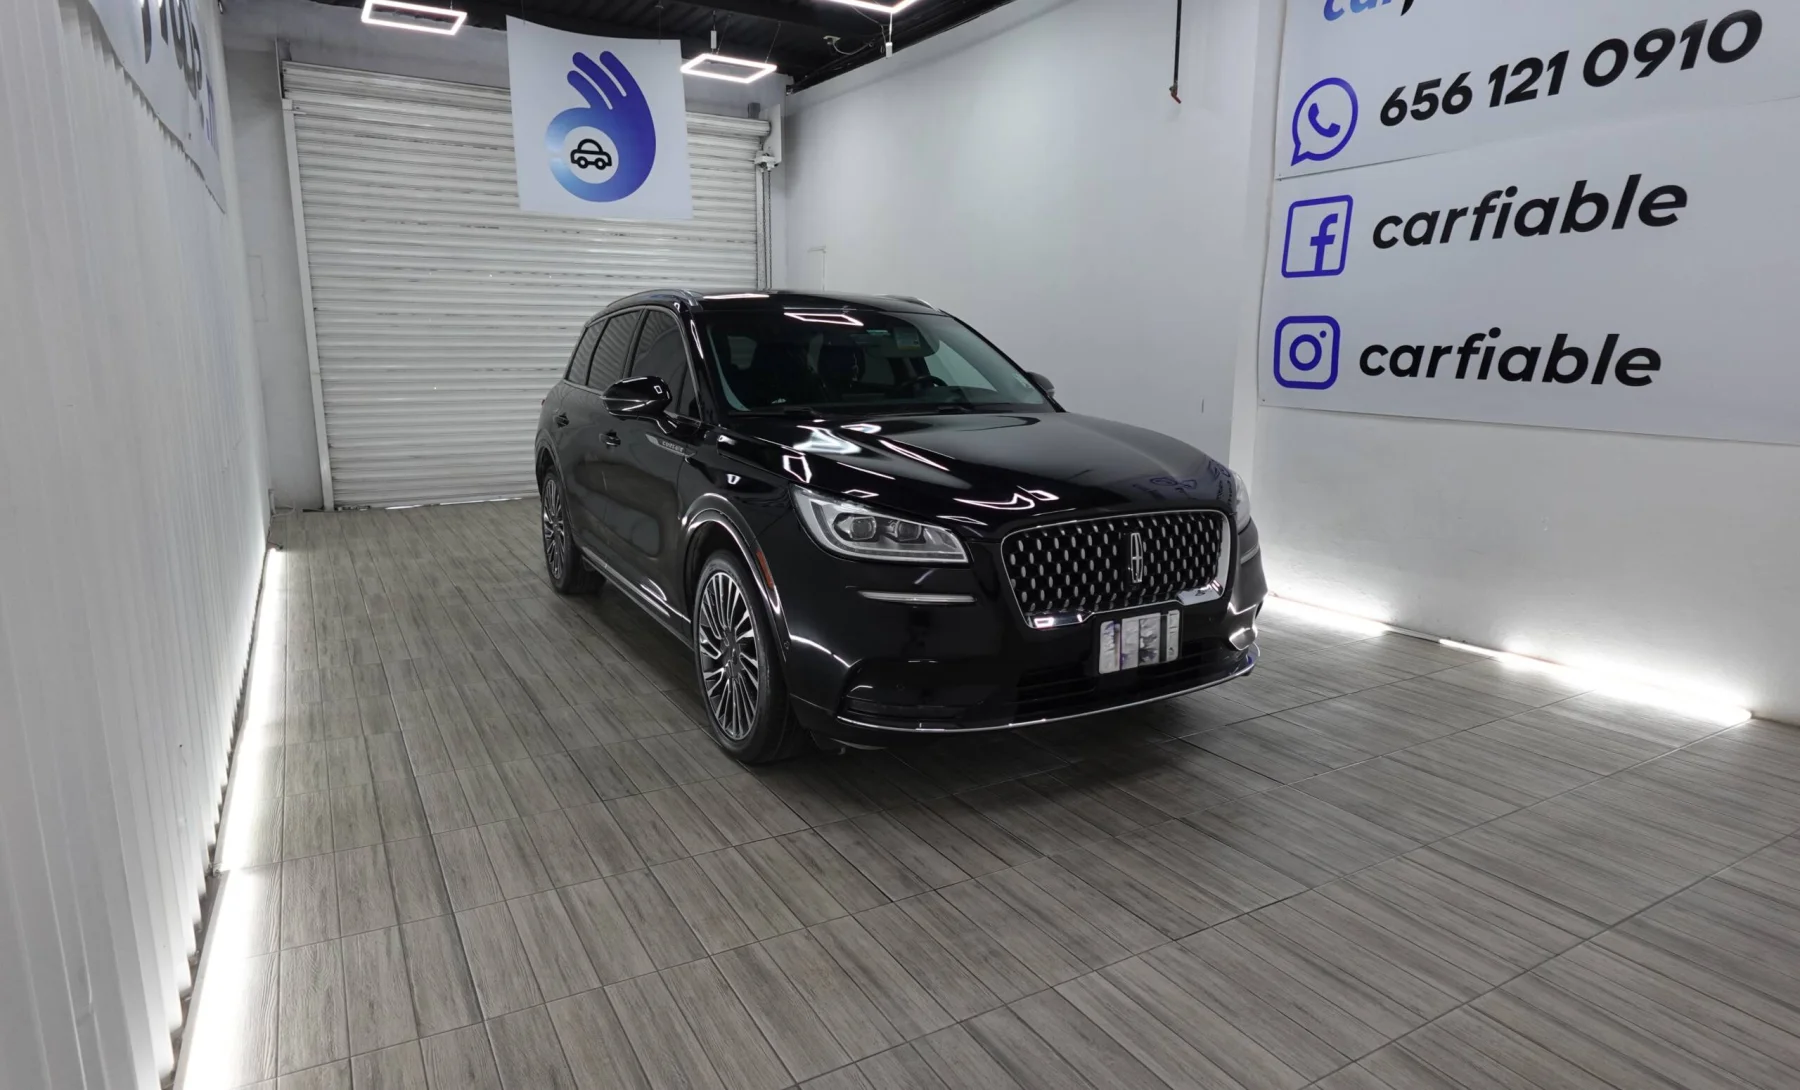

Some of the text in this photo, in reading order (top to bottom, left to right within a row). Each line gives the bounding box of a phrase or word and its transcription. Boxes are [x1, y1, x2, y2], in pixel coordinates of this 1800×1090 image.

[1379, 9, 1764, 127] 656 121 0910
[1371, 173, 1689, 250] carfiable
[1358, 327, 1662, 387] carfiable
